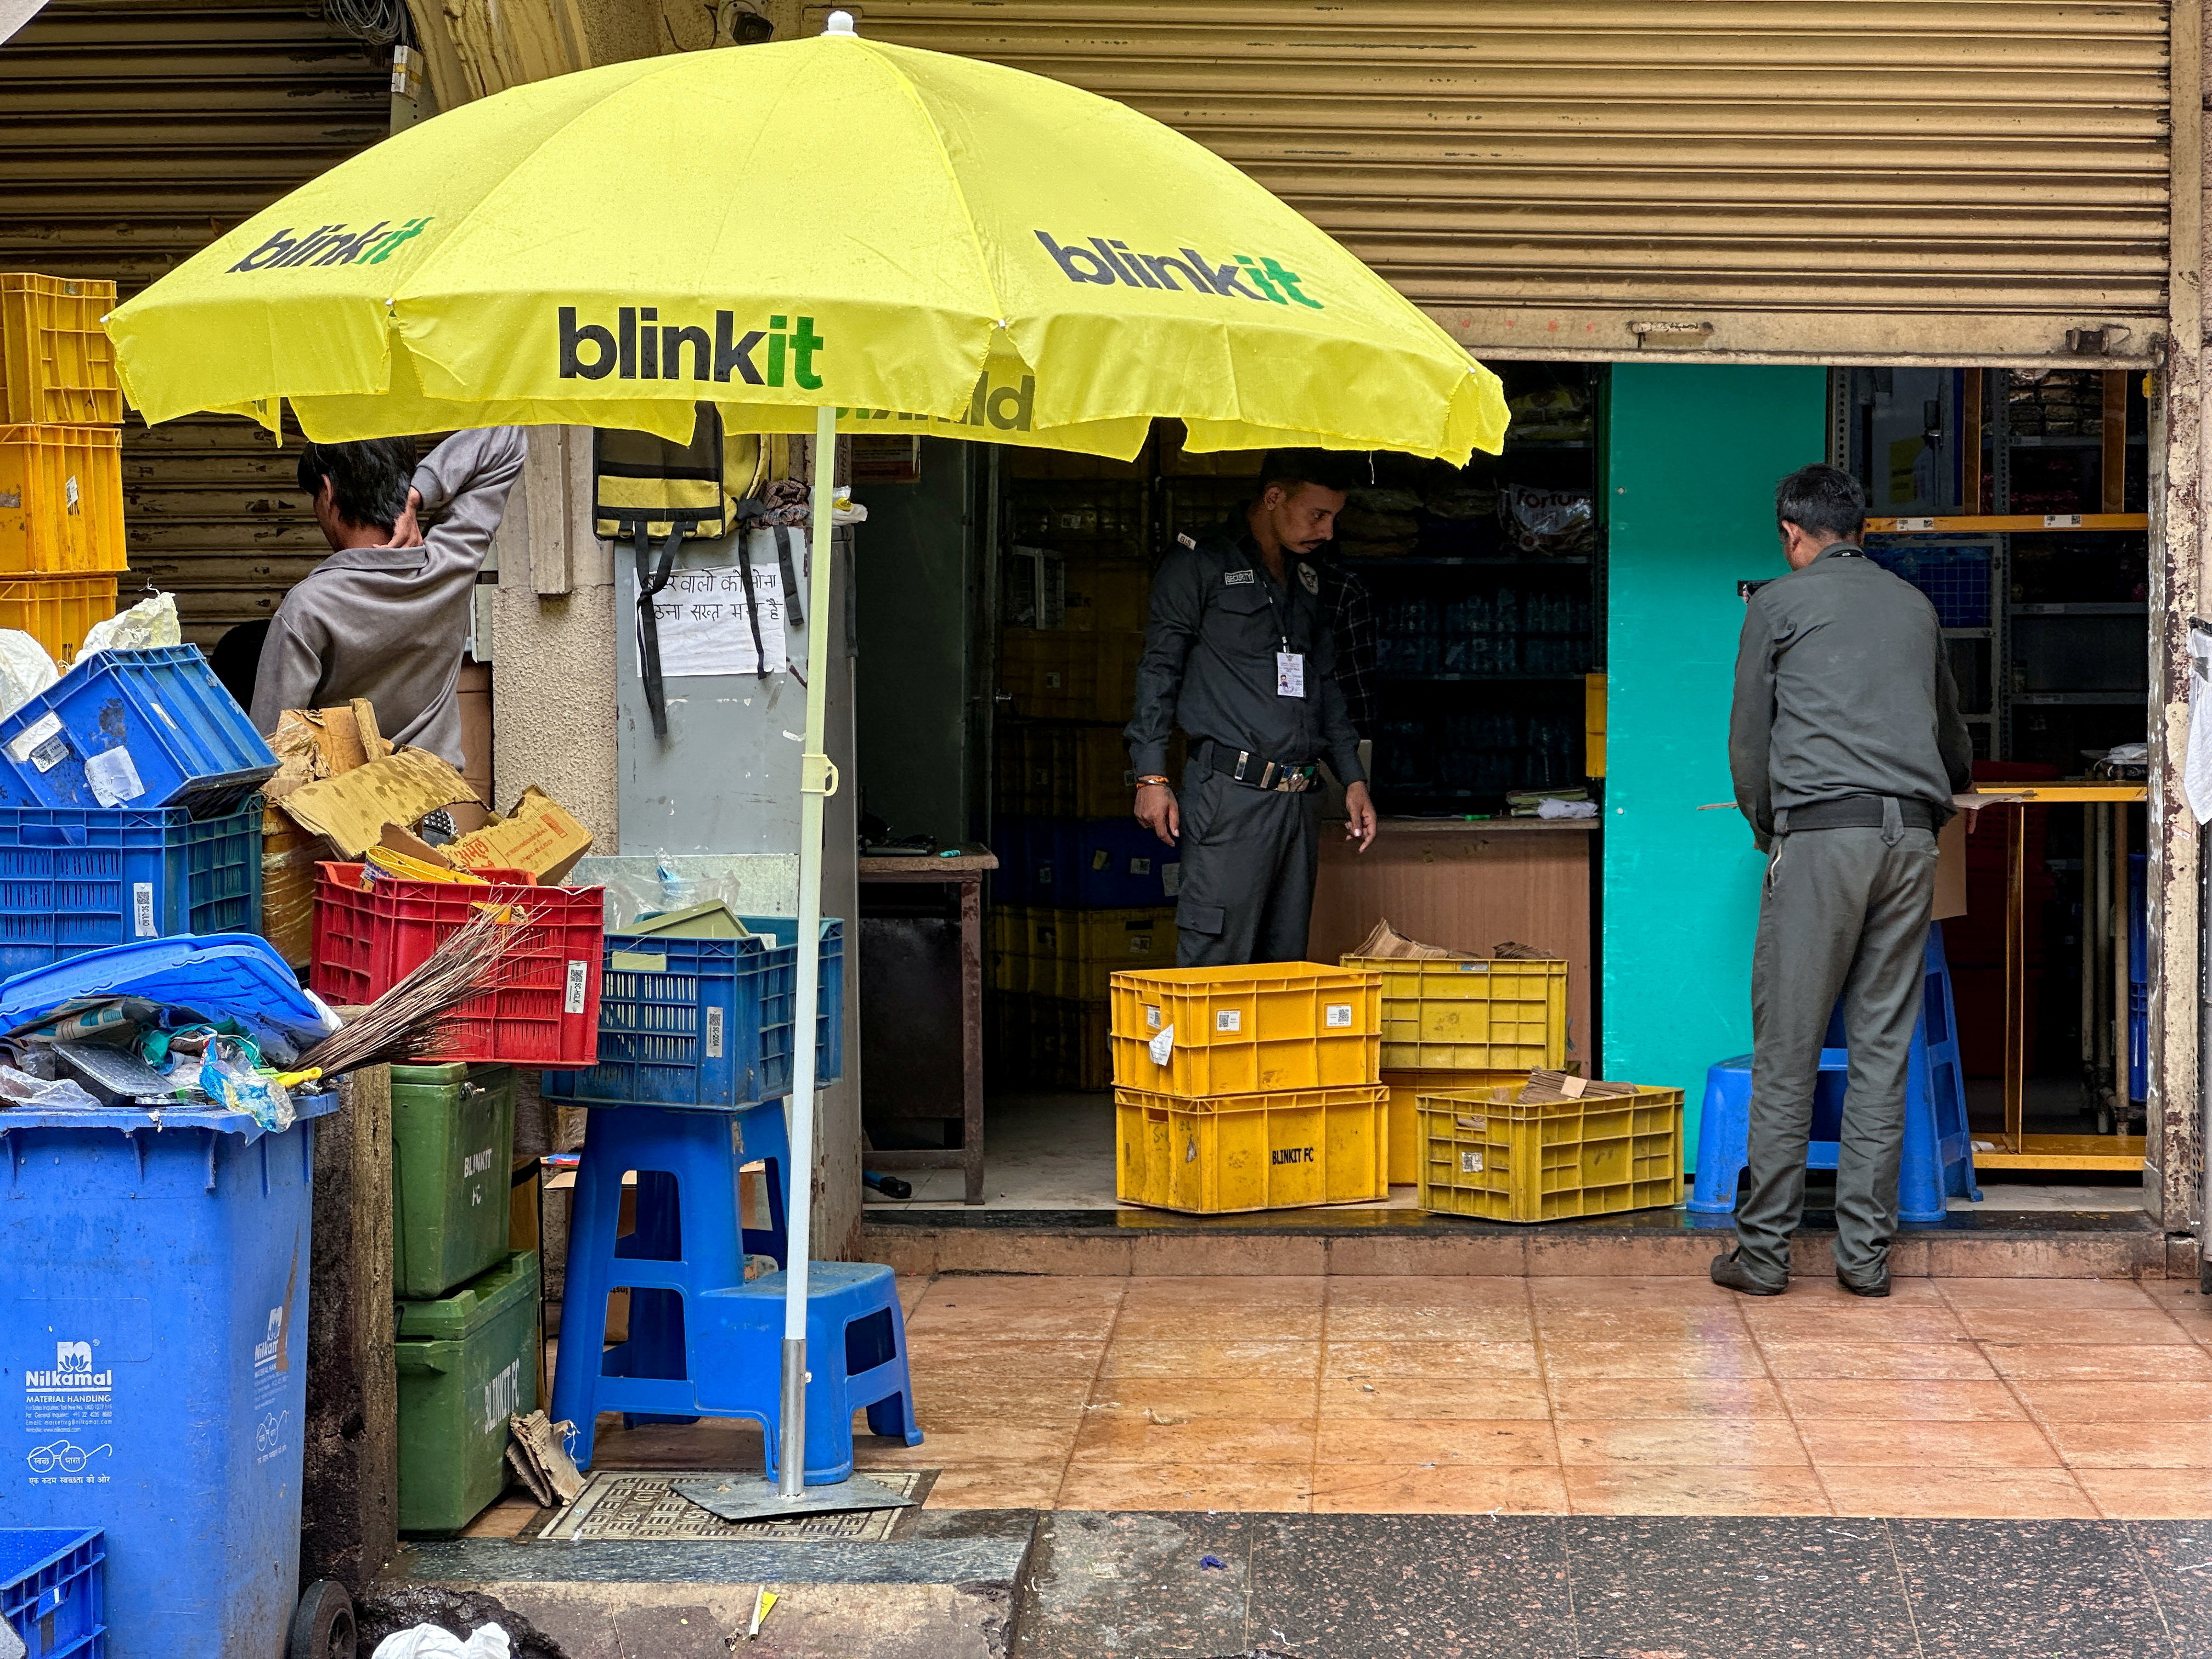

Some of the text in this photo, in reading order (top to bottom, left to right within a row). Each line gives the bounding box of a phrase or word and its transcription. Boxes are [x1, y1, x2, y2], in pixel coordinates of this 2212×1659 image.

[224, 217, 436, 273] blinkit
[1033, 230, 1324, 309] blinkit
[558, 306, 824, 390] blinkit
[1180, 535, 1192, 546] BIS
[1226, 573, 1251, 583] SECURITY
[464, 1148, 493, 1178] BLINKIT
[1272, 1147, 1314, 1165] BLINKIT FC
[26, 1369, 112, 1386] Nilkamal
[484, 1365, 511, 1435] BLINKIT
[29, 1477, 39, 1486] एक
